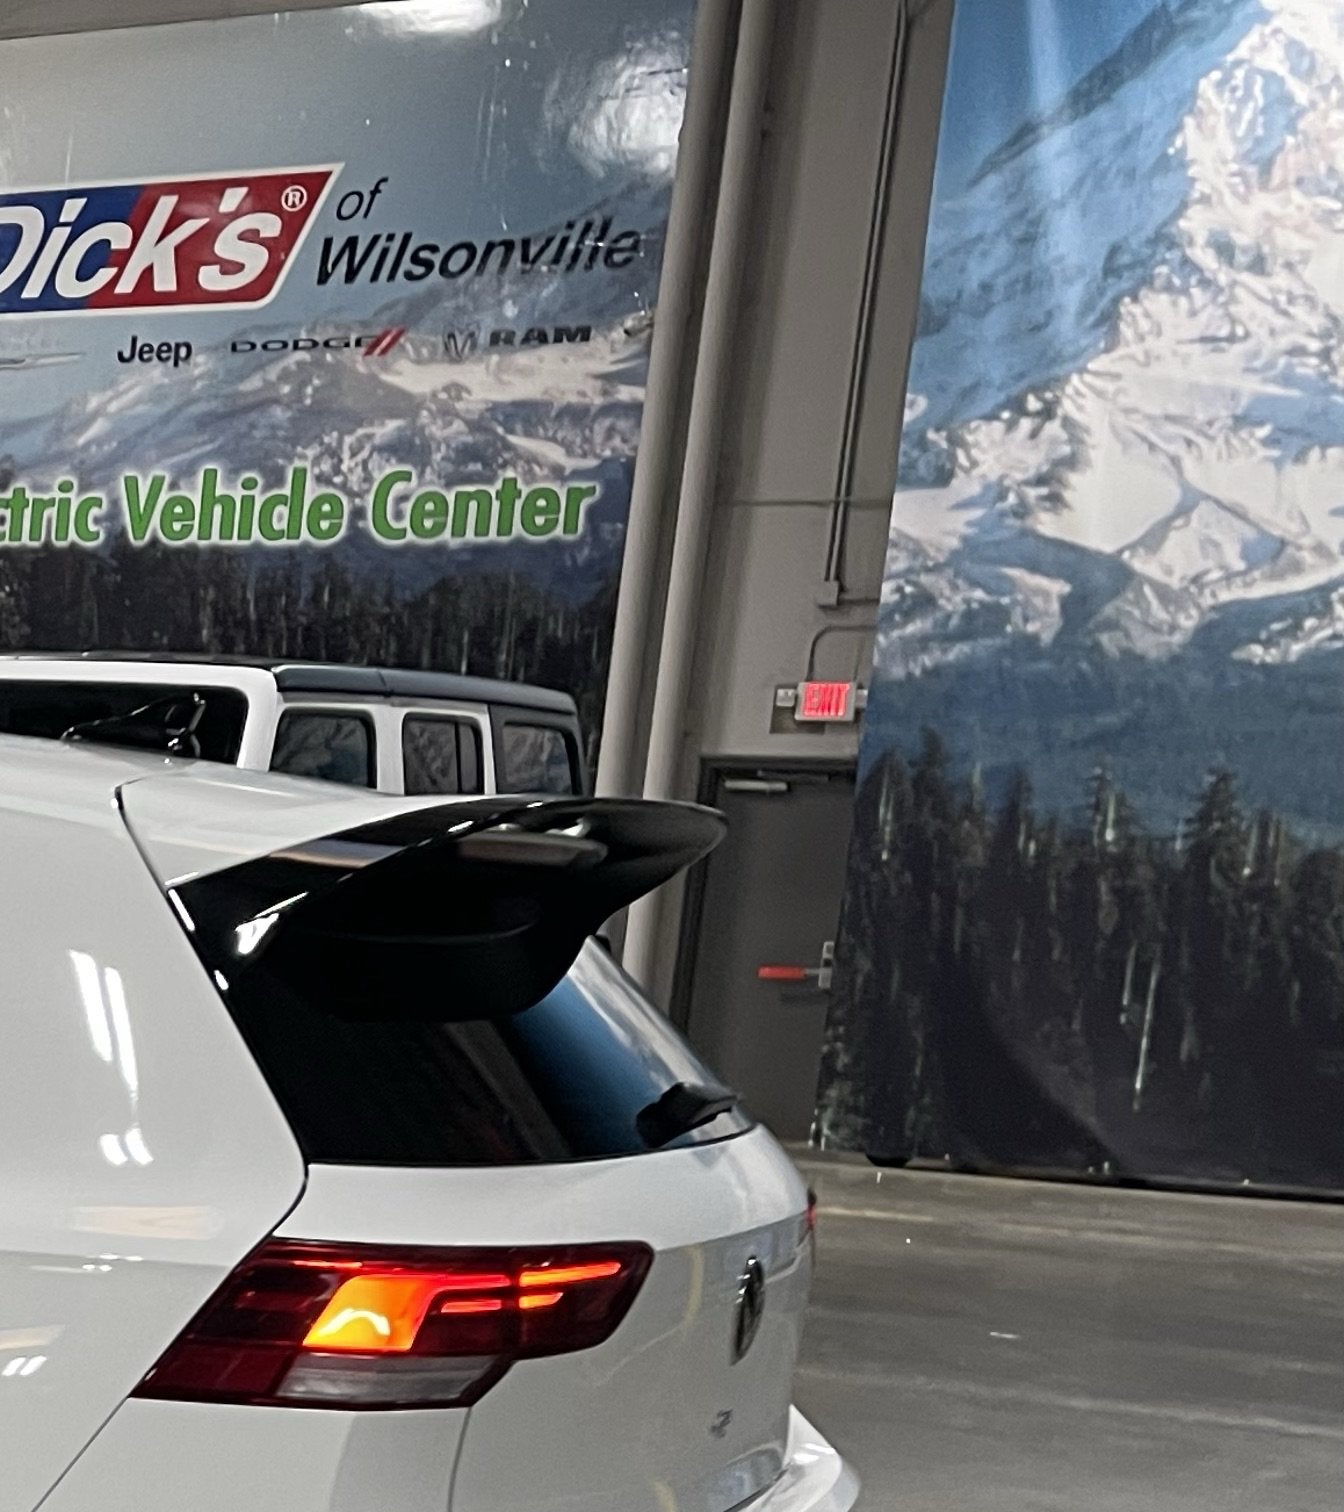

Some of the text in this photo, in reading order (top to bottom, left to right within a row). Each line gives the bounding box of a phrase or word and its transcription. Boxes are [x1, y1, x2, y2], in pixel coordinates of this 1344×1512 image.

[335, 177, 389, 221] of
[316, 215, 642, 286] Wilsonville
[116, 335, 193, 368] Jeep
[489, 325, 592, 347] RAM
[123, 467, 345, 542] Vehicle
[372, 469, 597, 541] Center
[803, 682, 851, 717] EXIT
